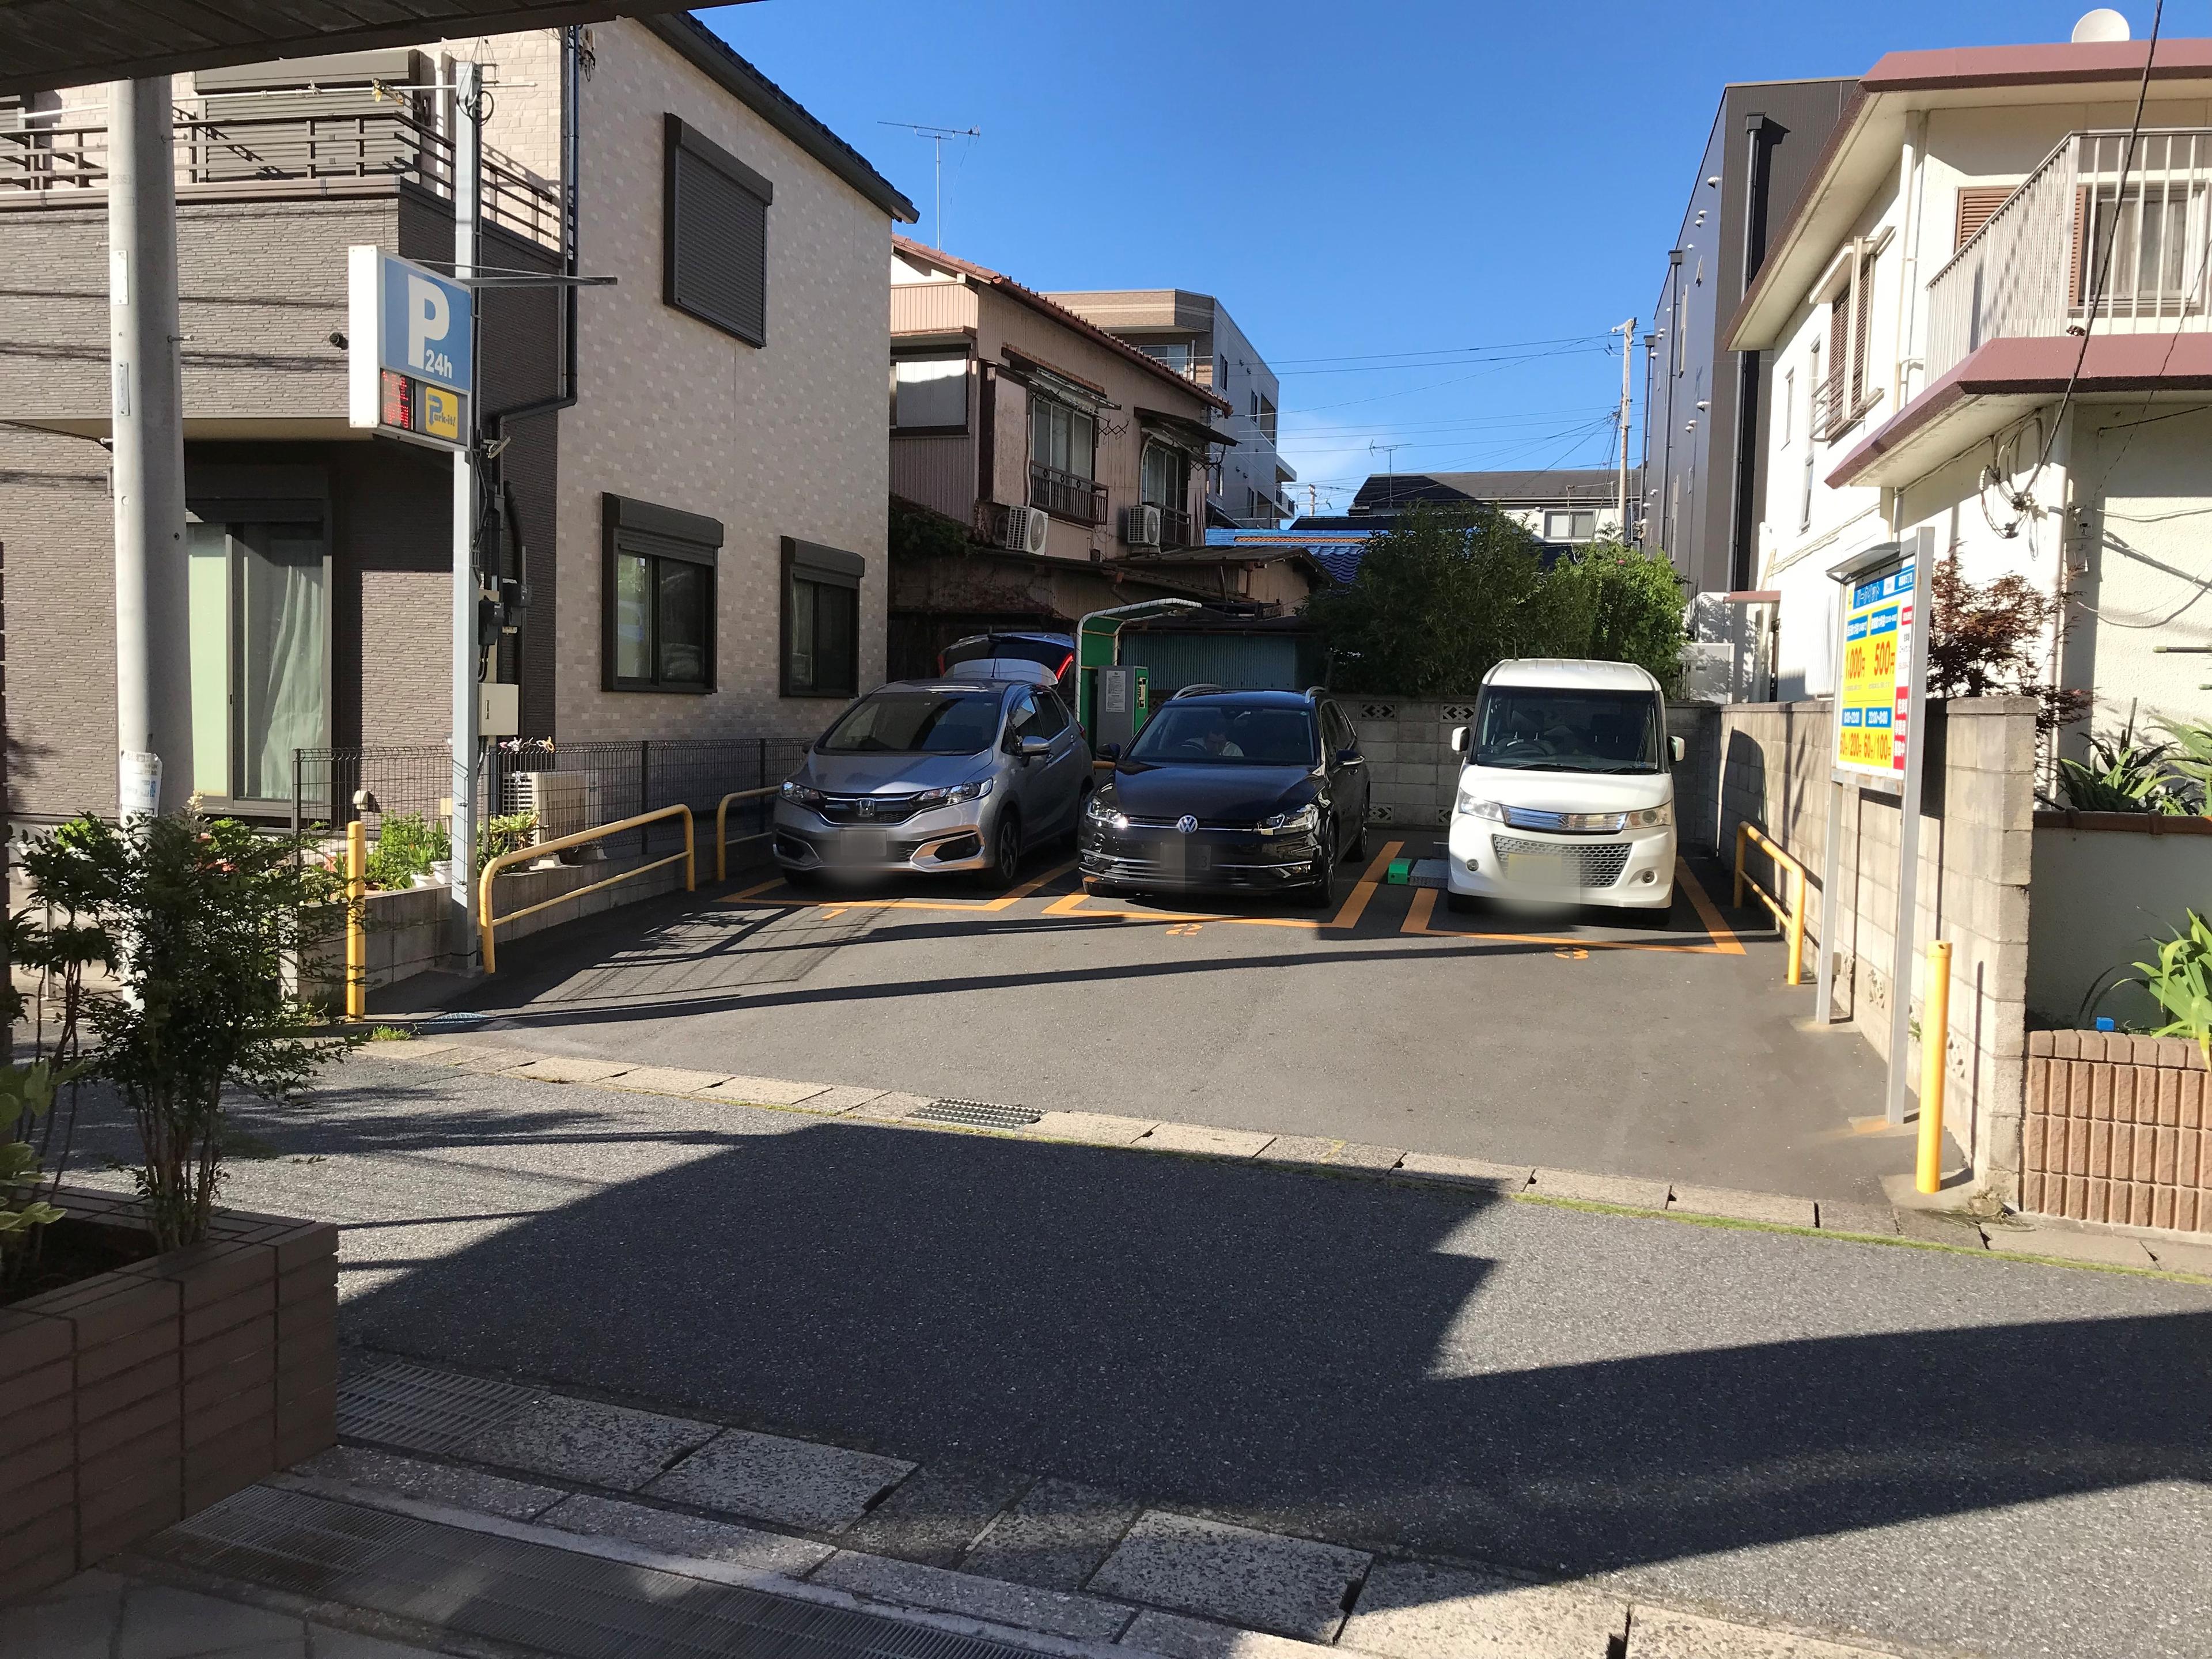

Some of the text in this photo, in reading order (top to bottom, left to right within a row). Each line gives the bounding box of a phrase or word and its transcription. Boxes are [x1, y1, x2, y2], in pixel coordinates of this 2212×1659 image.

[408, 274, 450, 369] P
[425, 349, 452, 379] 24h
[1874, 640, 1895, 676] 500円
